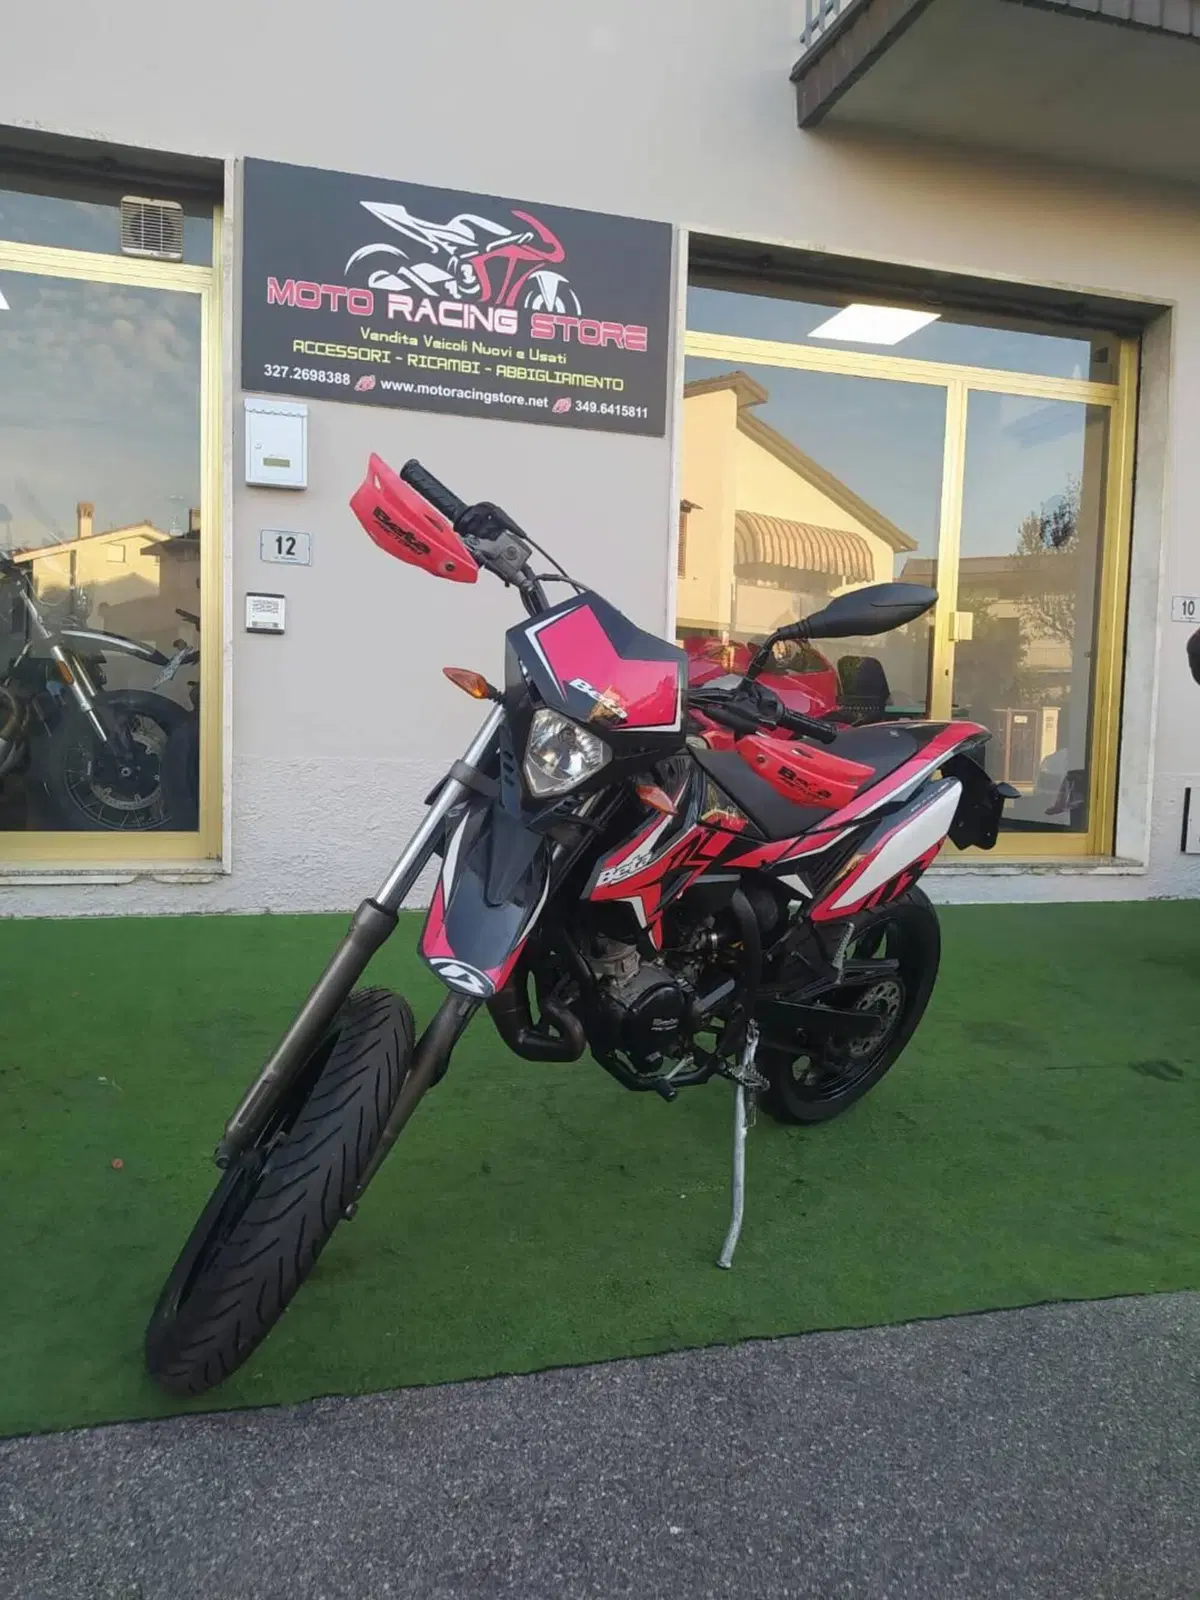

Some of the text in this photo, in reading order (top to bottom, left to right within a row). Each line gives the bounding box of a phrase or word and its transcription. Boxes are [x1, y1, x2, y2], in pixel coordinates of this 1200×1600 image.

[267, 276, 648, 352] MOTO RACING STORE
[360, 326, 567, 364] Vendita Veicoli Nuovi e Usati
[293, 340, 391, 364] ACCESSORI
[407, 353, 480, 374] RICAMBI
[496, 364, 624, 391] ABBIGLIAMENTO
[264, 364, 648, 418] 327.2698388 www.motoracingstore.net 349.6415811
[275, 535, 296, 556] 12
[1182, 600, 1195, 616] 10
[596, 852, 652, 888] Beta
